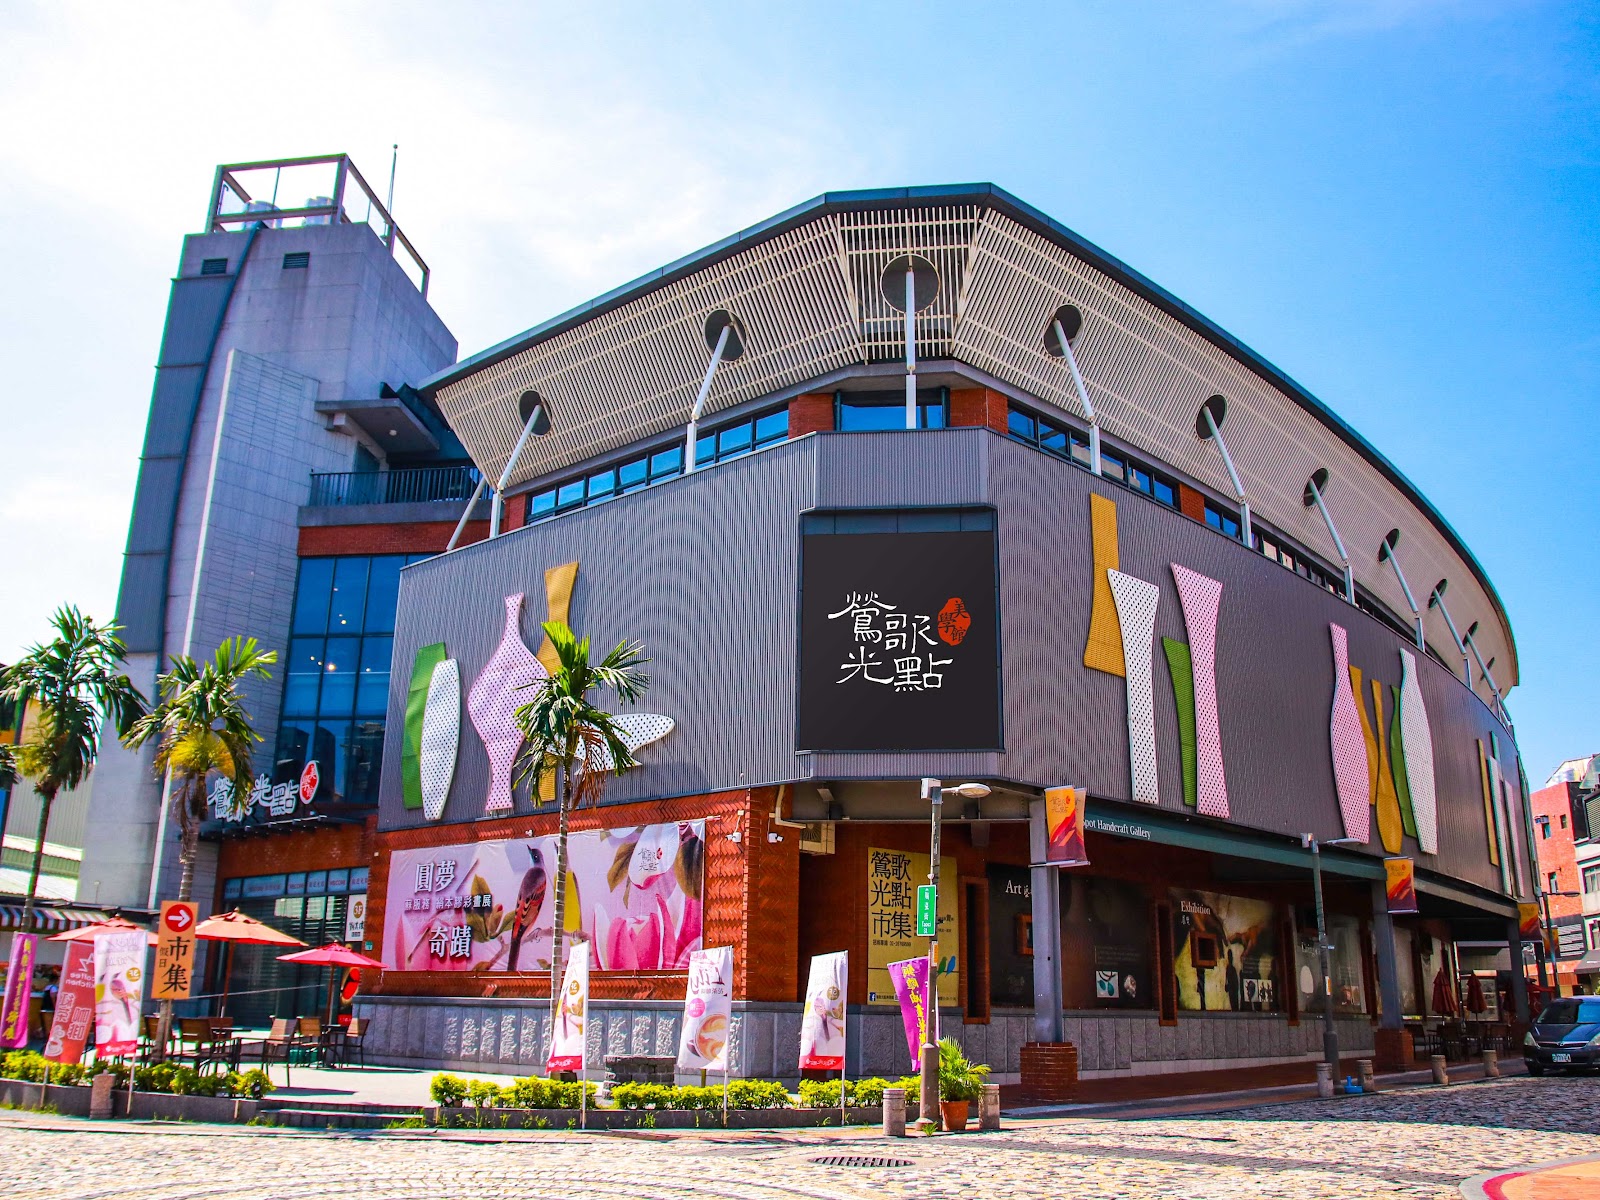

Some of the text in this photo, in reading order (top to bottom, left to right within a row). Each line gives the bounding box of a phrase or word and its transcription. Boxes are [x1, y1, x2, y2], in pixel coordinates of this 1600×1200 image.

[828, 591, 938, 654] 鶯歌
[836, 646, 953, 692] 光點
[207, 773, 300, 822] 鶯光點
[1097, 819, 1129, 835] Handcraft
[1129, 825, 1151, 840] Gallery
[414, 860, 457, 893] 圓夢
[870, 851, 912, 881] 鶯歌
[870, 880, 912, 909] 光點
[1005, 880, 1021, 895] Art
[353, 905, 363, 915] 3F
[1180, 900, 1211, 915] Exhibition
[872, 909, 912, 939] 市集
[428, 925, 472, 958] 奇蹟
[159, 947, 169, 968] 假日
[160, 936, 190, 994] 市集
